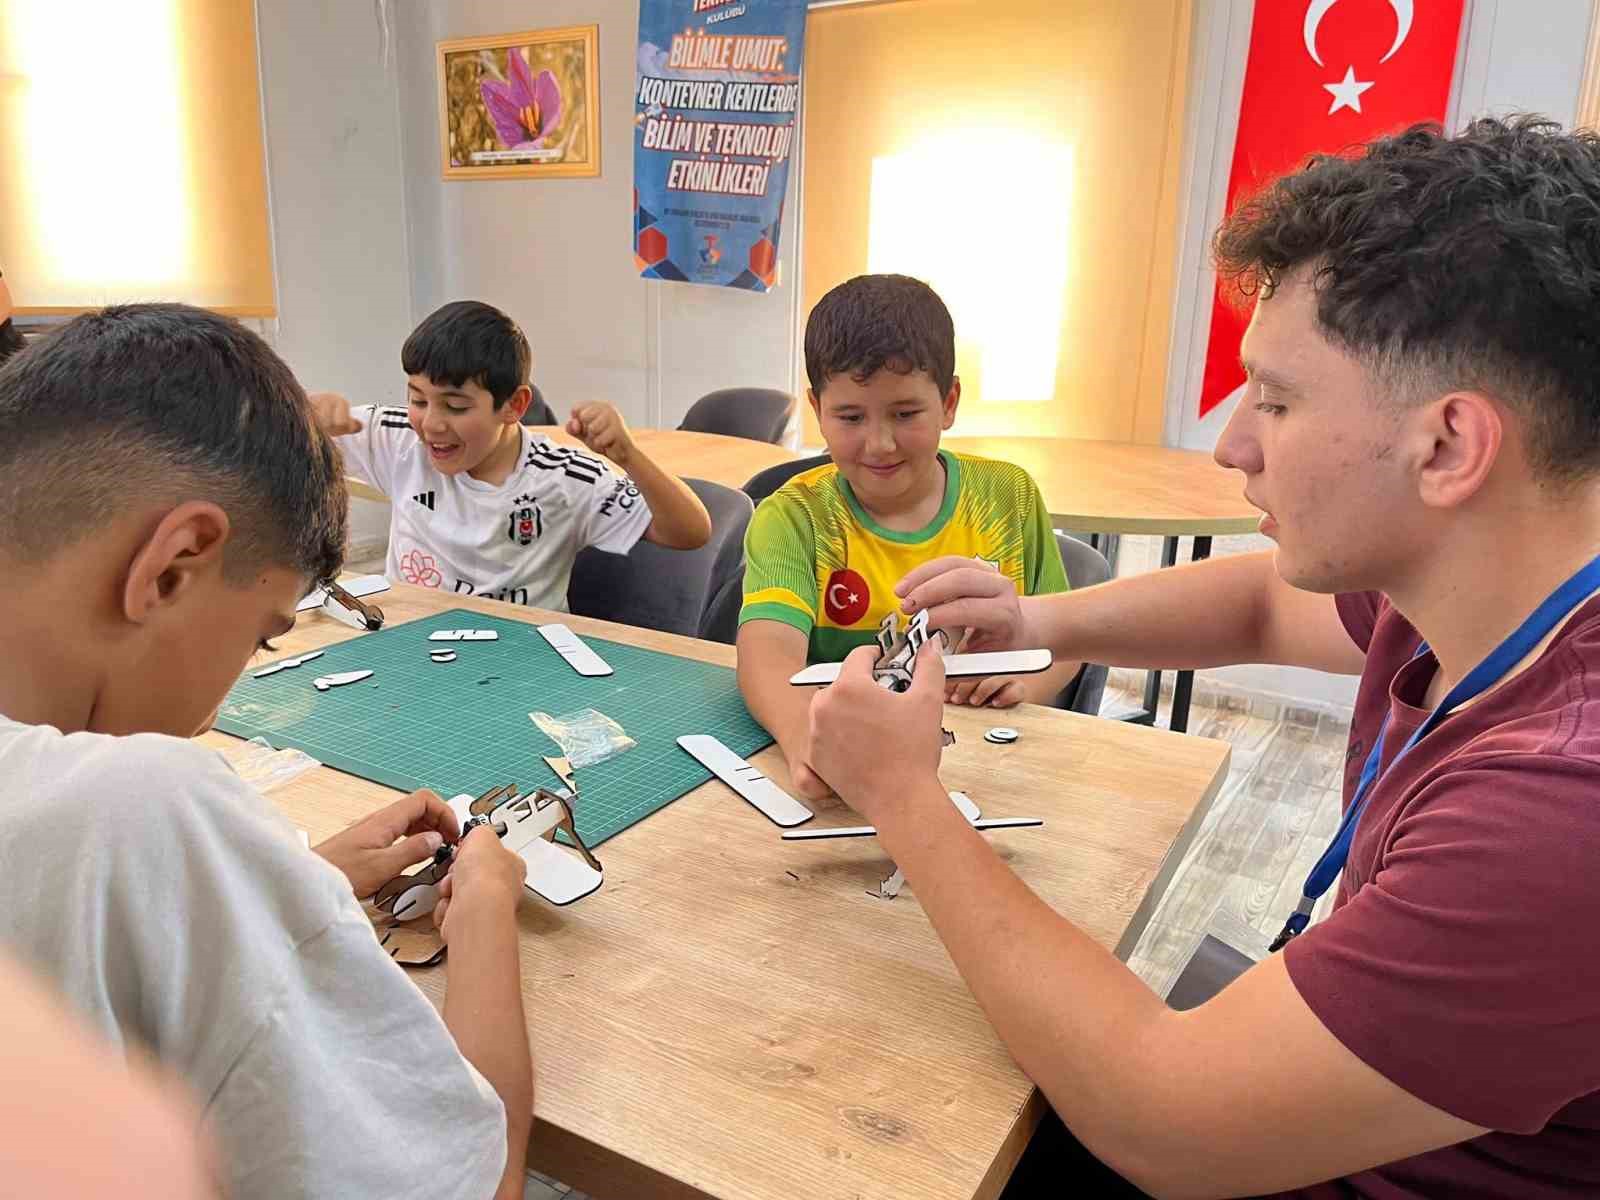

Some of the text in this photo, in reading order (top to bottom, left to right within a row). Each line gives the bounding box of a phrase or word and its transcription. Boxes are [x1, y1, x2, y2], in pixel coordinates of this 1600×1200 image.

[670, 27, 787, 71] BİLİMLE UMUT:
[638, 78, 725, 111] KONTEYNER
[642, 113, 794, 163] BİLİM VE TEKNOLOJİ
[667, 155, 771, 196] ETKİNLİKLERİ
